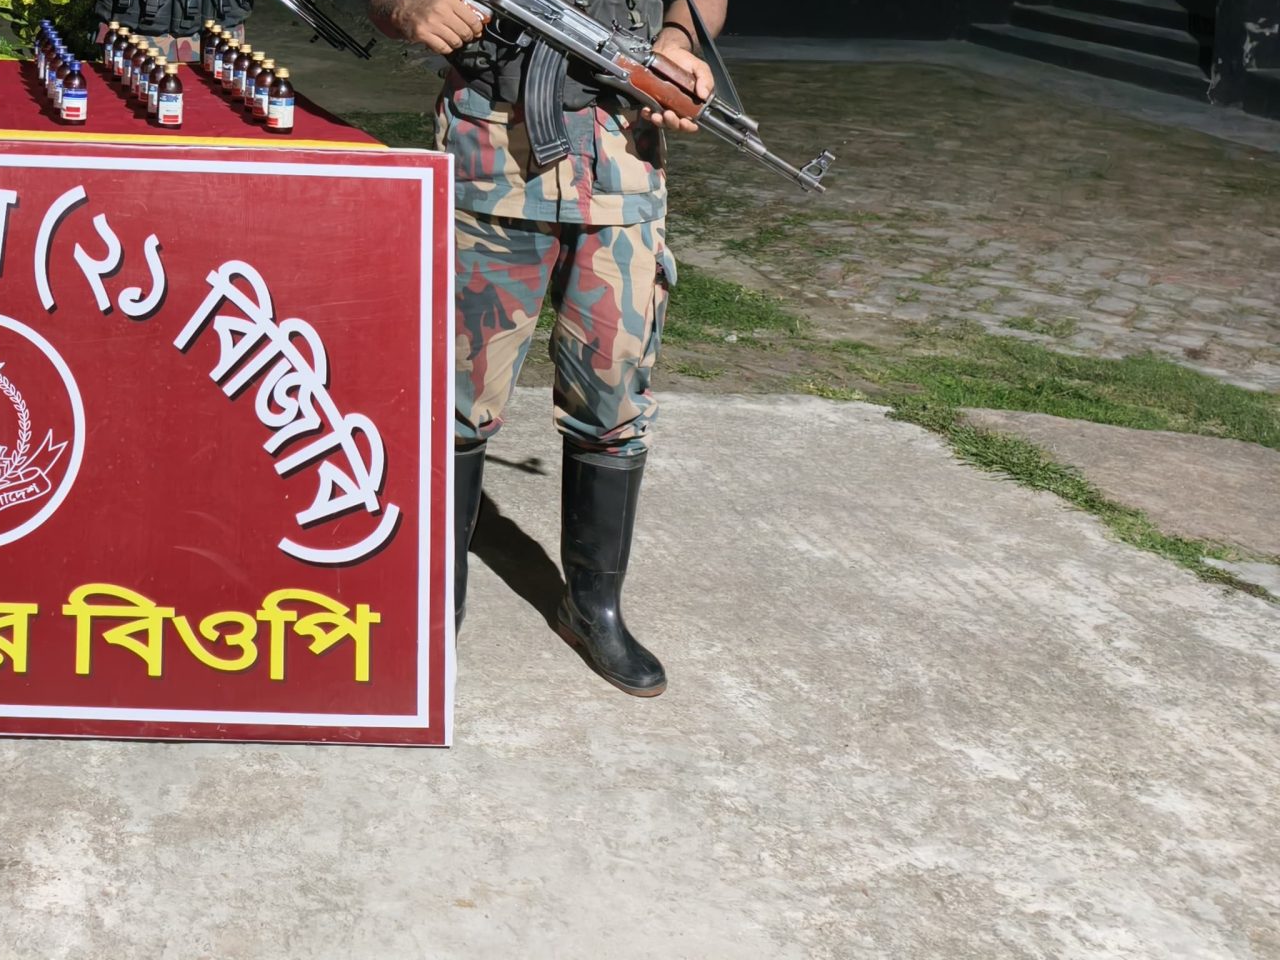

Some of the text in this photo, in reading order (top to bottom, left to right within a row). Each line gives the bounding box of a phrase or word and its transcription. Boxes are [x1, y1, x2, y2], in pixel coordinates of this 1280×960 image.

[34, 185, 165, 316] (২১
[173, 259, 400, 563] বিজিবি)
[62, 583, 382, 682] বিওপি
